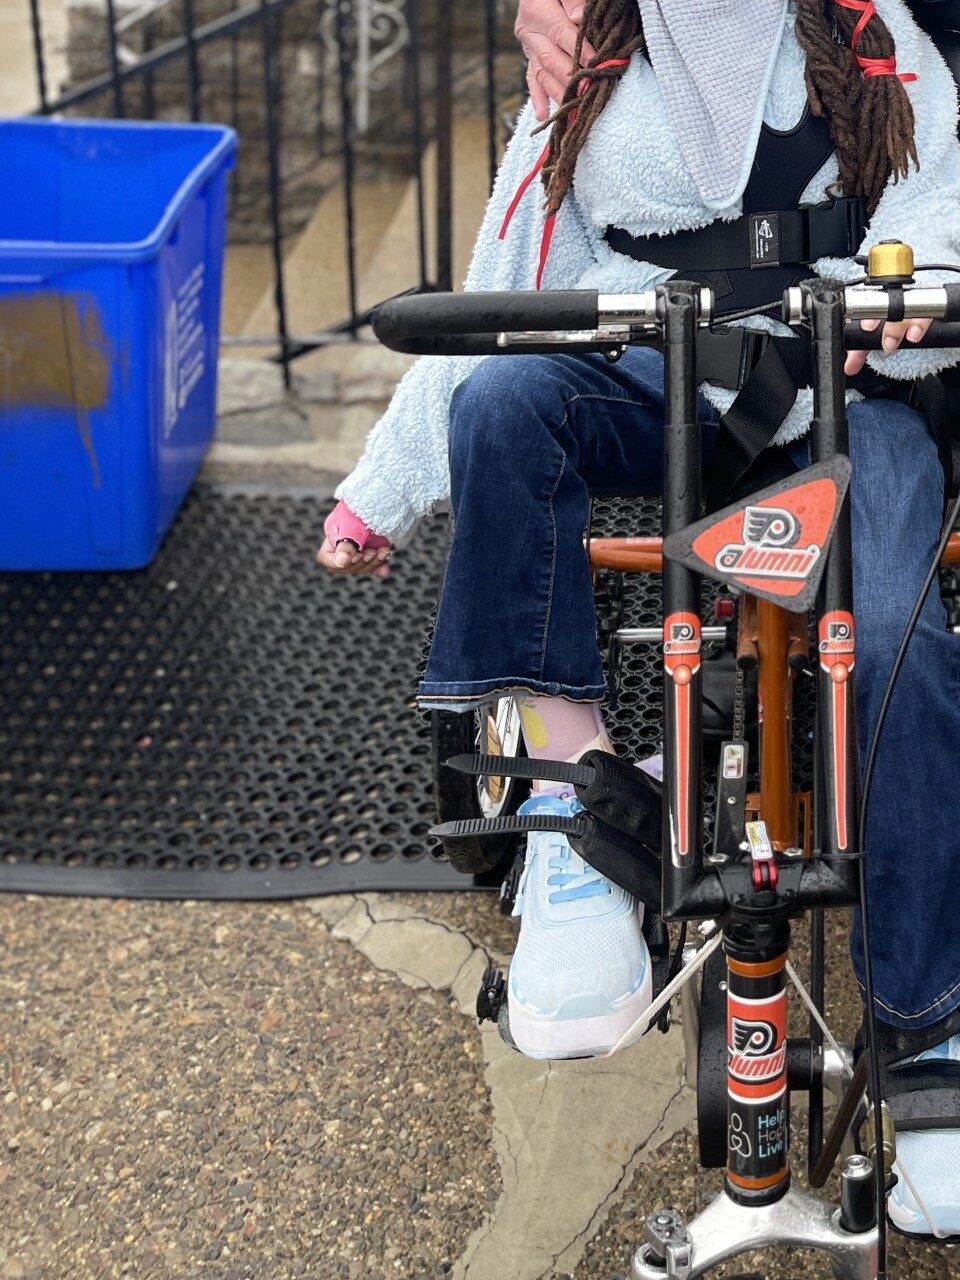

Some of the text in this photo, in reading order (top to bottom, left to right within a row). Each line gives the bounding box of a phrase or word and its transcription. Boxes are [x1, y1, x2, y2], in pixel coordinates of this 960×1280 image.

[717, 546, 818, 577] alumni
[758, 1109, 785, 1129] Help
[758, 1126, 783, 1143] Hop
[758, 1140, 783, 1158] Live
